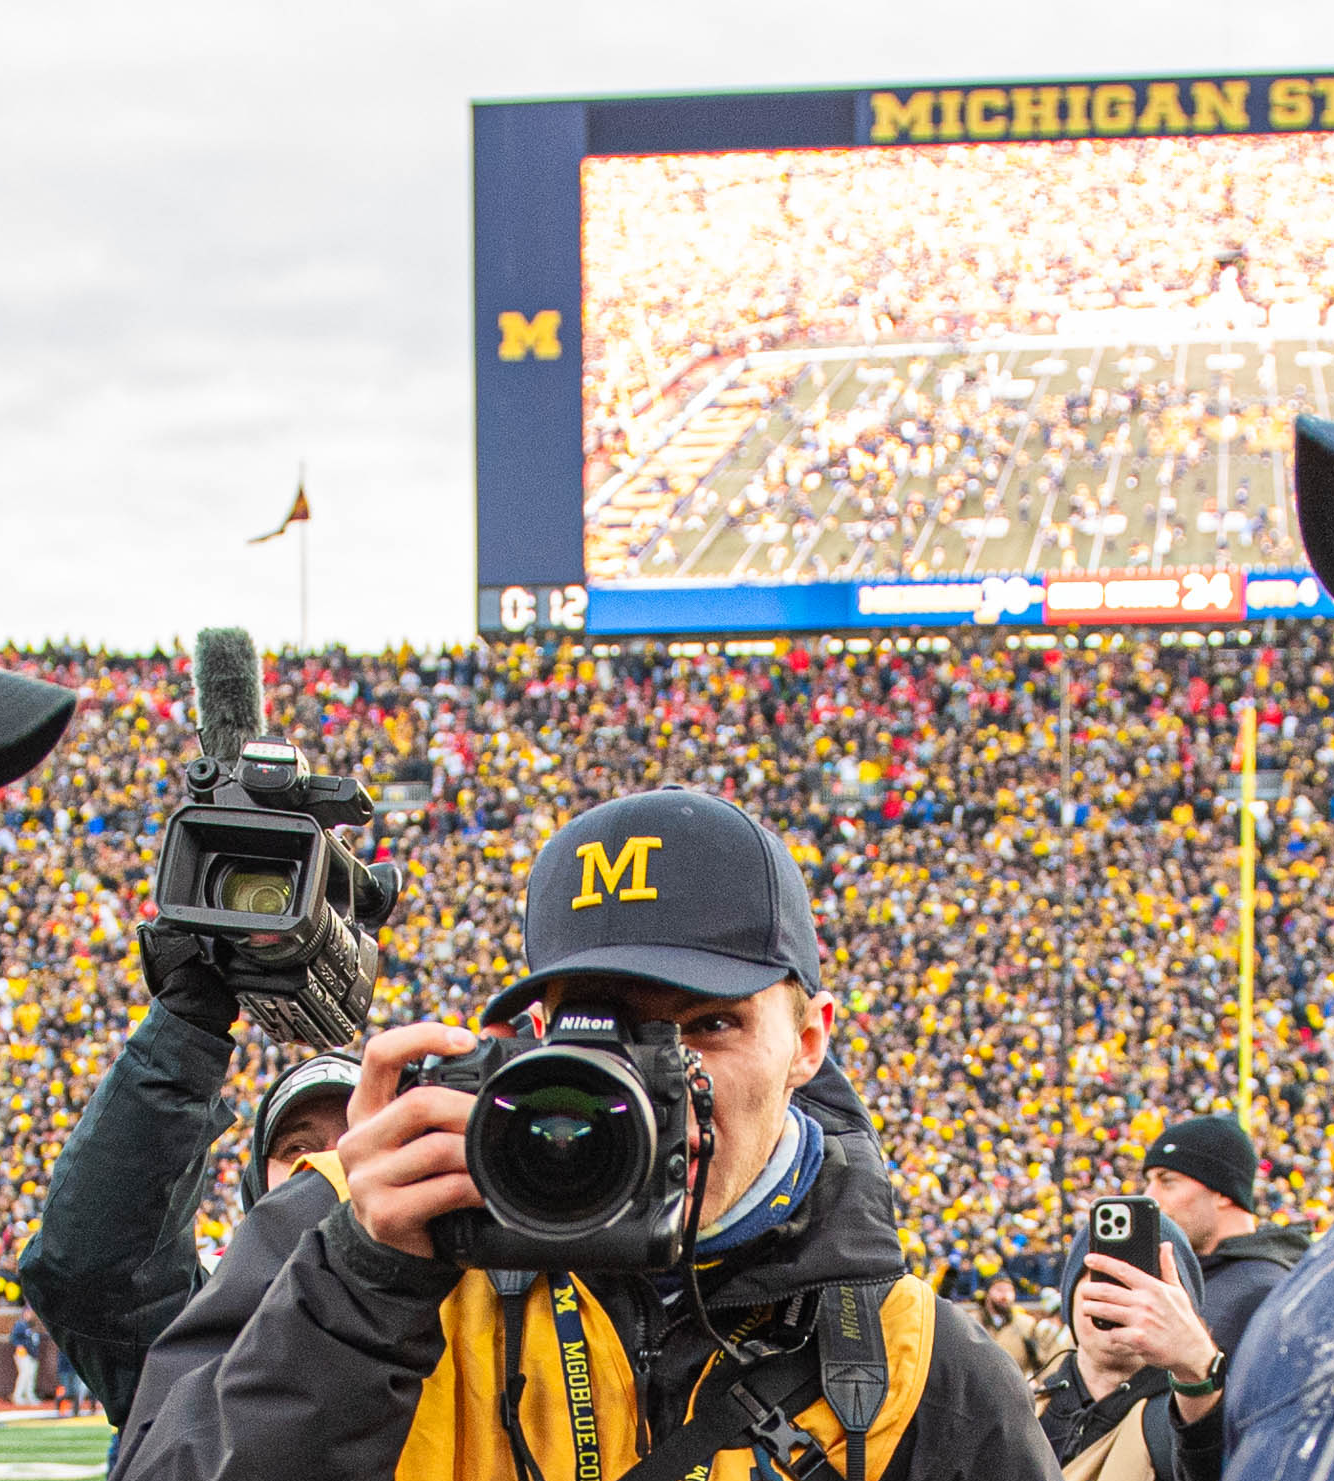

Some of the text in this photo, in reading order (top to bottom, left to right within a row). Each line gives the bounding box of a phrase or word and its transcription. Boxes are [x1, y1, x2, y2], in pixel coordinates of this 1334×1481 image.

[870, 81, 1251, 142] MICHIGAN
[498, 310, 562, 361] M
[571, 836, 662, 911] M
[559, 1015, 615, 1031] Nikon
[554, 1285, 578, 1315] M
